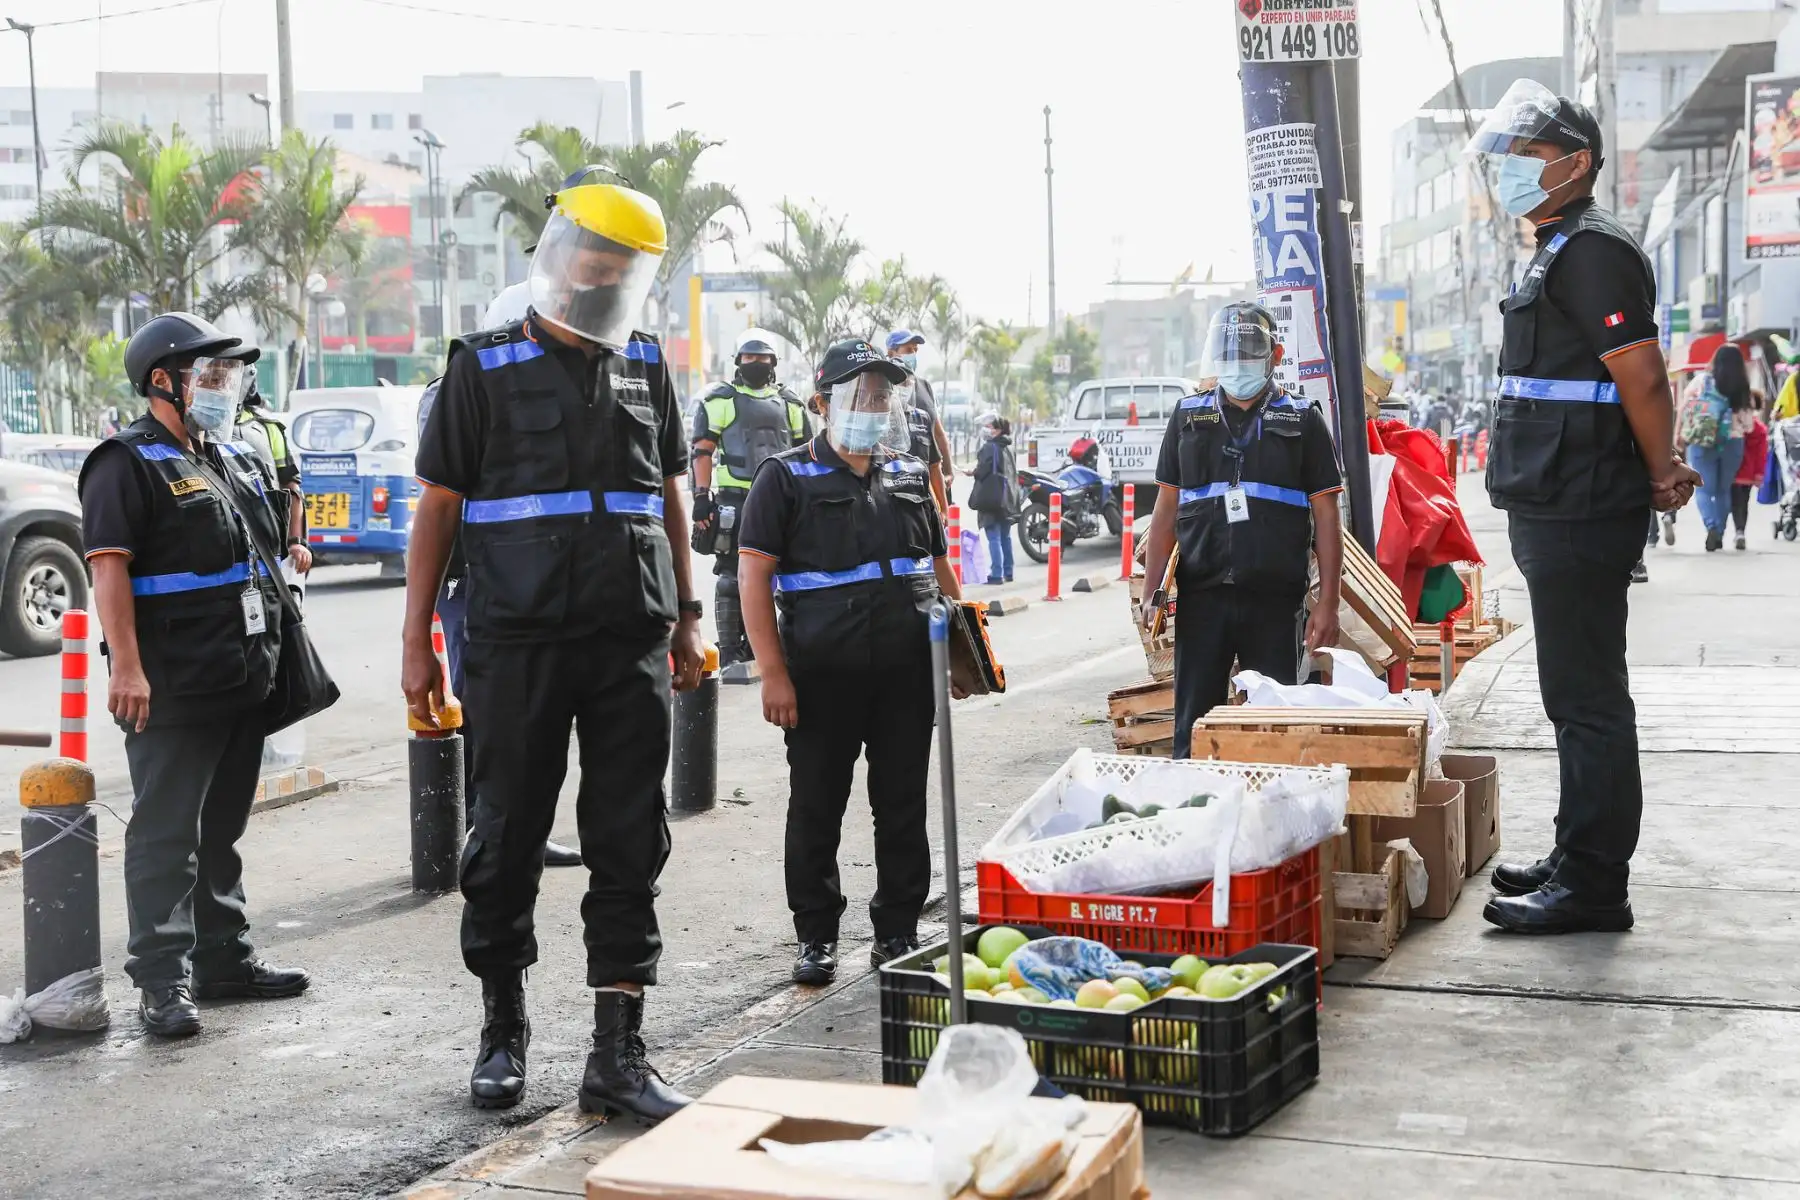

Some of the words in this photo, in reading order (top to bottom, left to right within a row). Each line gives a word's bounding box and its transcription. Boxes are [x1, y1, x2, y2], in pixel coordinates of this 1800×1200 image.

[1261, 12, 1293, 24] EXPERTO
[1294, 12, 1304, 23] EN
[1305, 11, 1323, 22] UNIR
[1325, 10, 1356, 22] PAREJAS
[1240, 25, 1274, 60] 921
[1281, 24, 1316, 58] 449
[1323, 22, 1359, 57] 108
[1247, 128, 1313, 147] OPORTUNIDAD
[1247, 148, 1255, 156] DE
[1256, 139, 1297, 152] TRABAJO
[1277, 149, 1286, 157] DE
[1253, 160, 1276, 172] GUAPAS
[1277, 159, 1282, 167] Y
[1283, 157, 1313, 166] DECIDIDAS
[1088, 903, 1125, 922] TIGRE
[1128, 905, 1157, 923] PT.7
